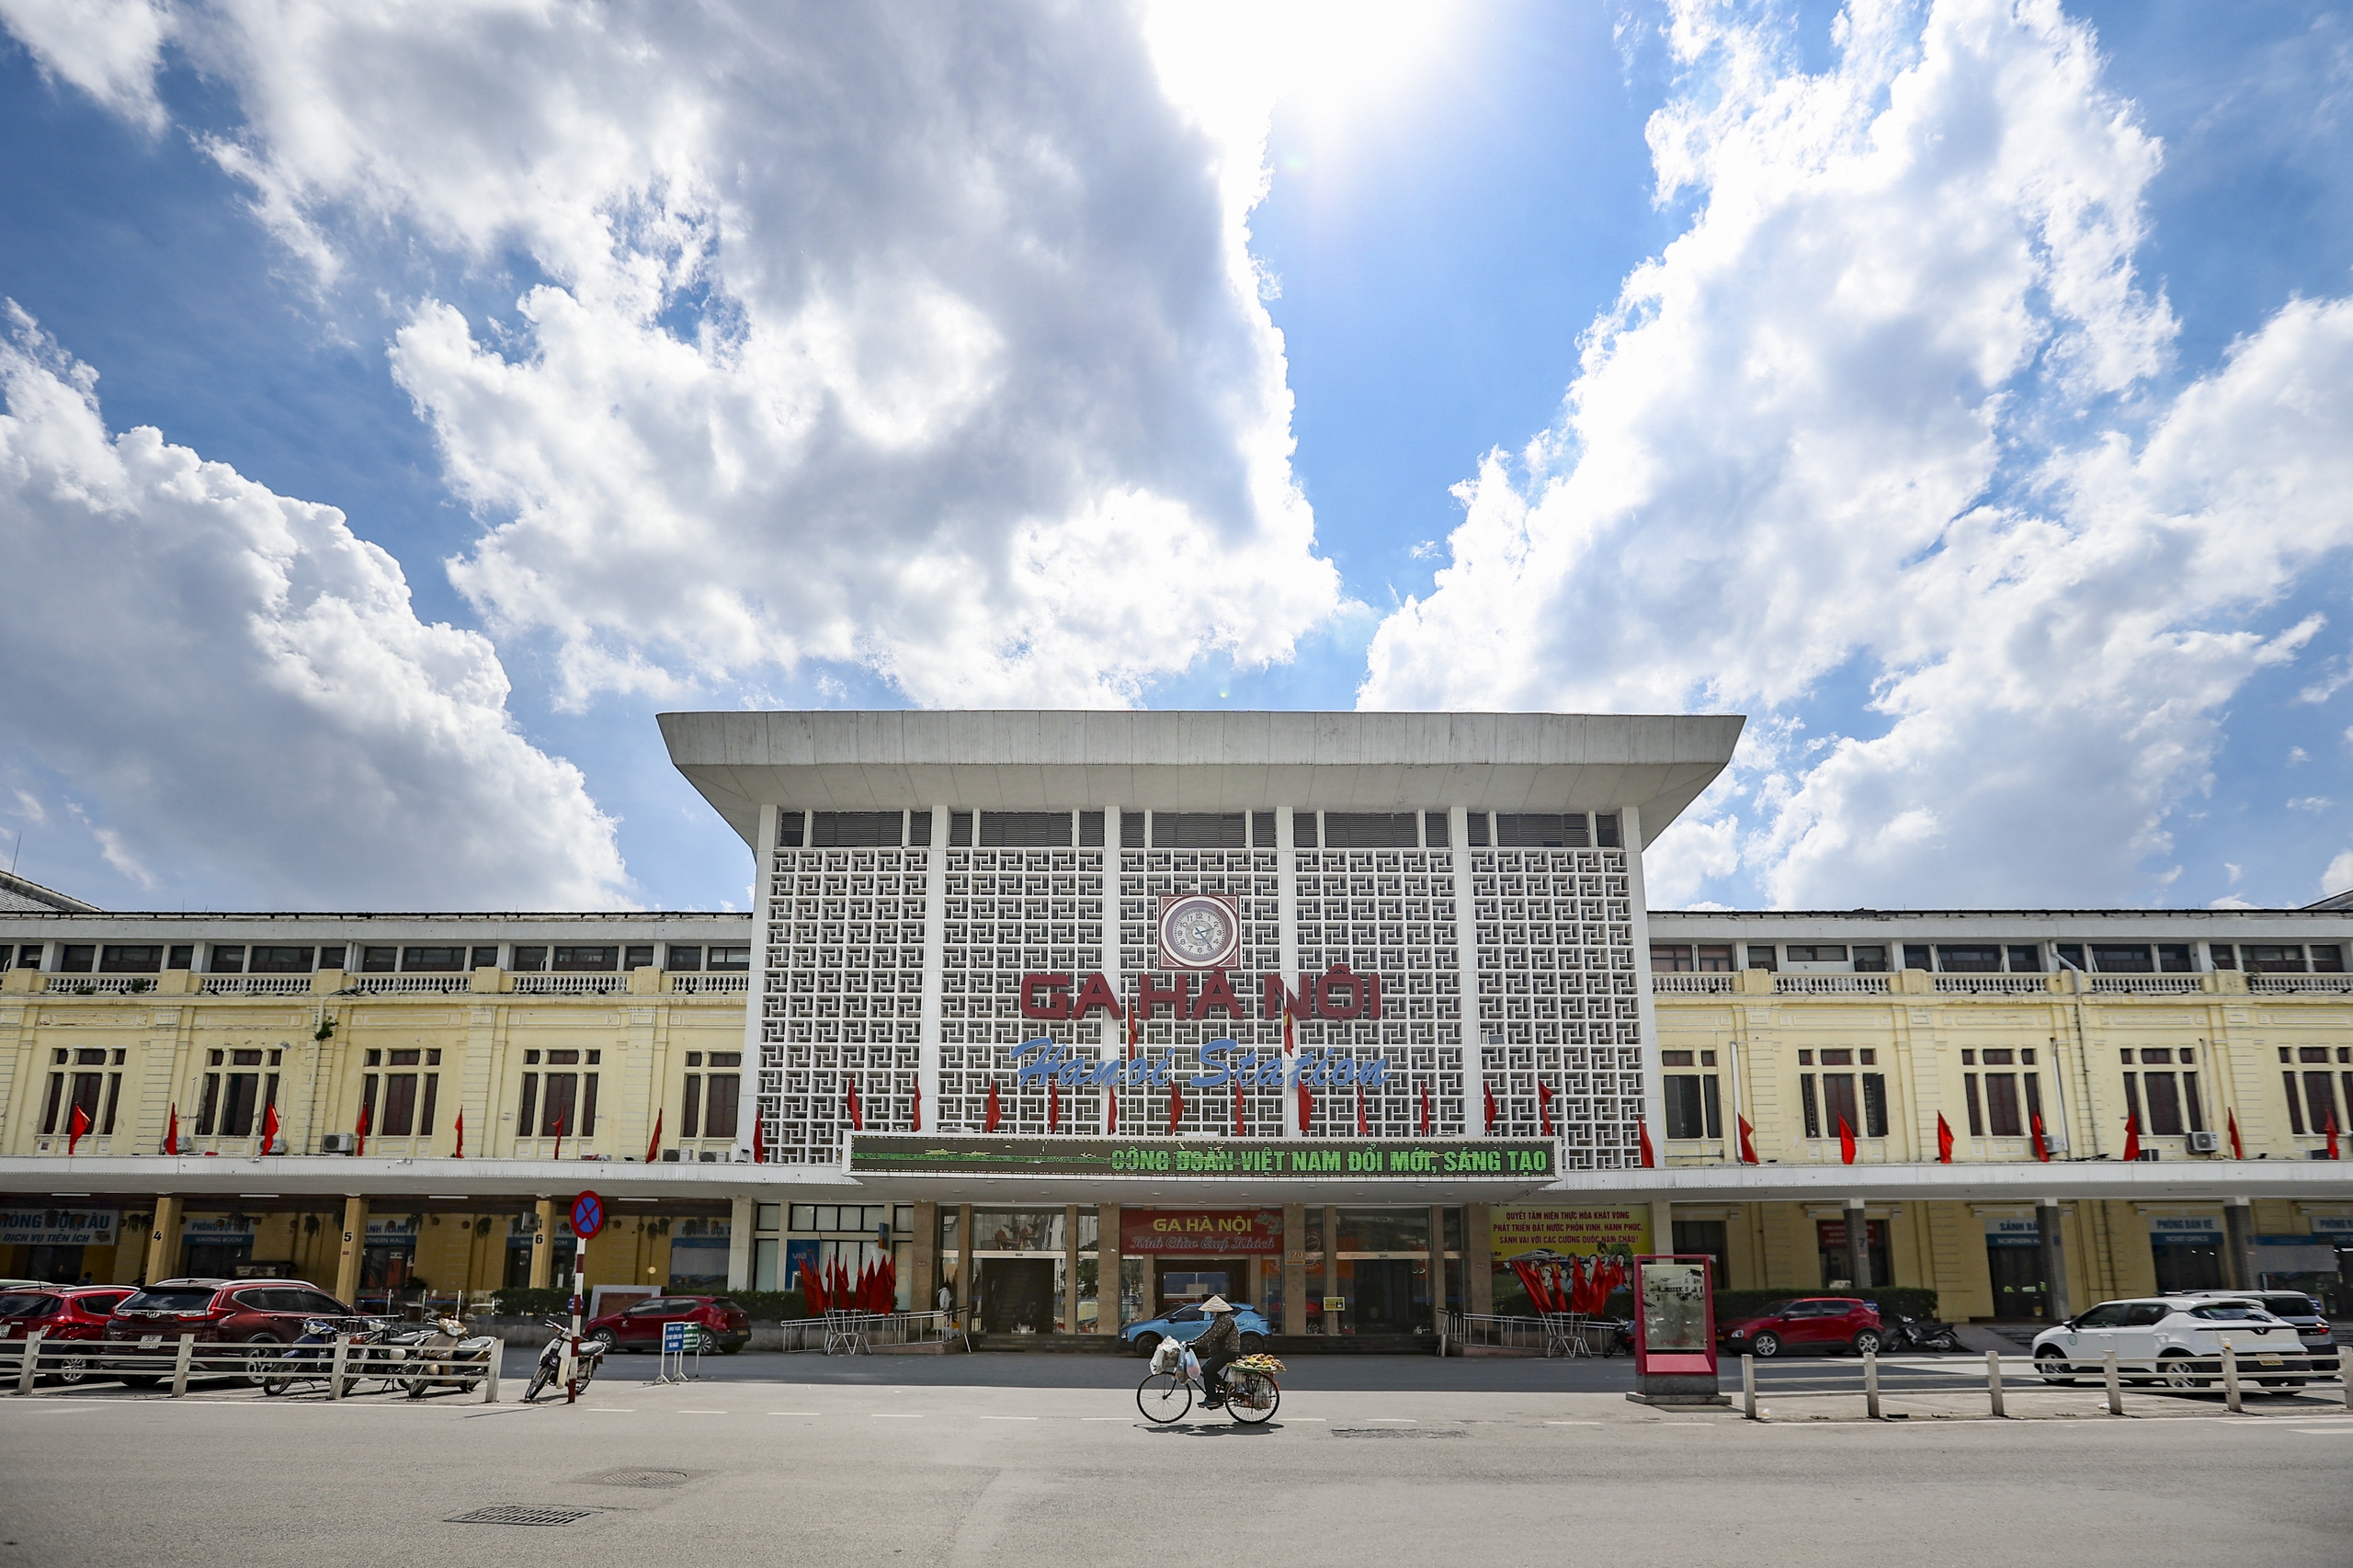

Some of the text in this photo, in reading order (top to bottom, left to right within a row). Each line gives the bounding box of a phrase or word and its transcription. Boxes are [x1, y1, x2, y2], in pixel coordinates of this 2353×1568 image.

[1019, 963, 1381, 1022] GA HÀ NỘI
[1011, 1037, 1392, 1088] Hanoi Station
[1111, 1145, 1169, 1171] CÔNG
[1241, 1146, 1286, 1176] VIỆT
[1291, 1150, 1341, 1171] NAM
[1347, 1142, 1383, 1172] ĐỔI
[1390, 1146, 1438, 1174] MỚI,
[1443, 1146, 1501, 1172] SÁNG
[1507, 1149, 1547, 1176] TẠO
[0, 1211, 42, 1228] ÒNG
[1153, 1215, 1252, 1234] GA HÀ NỘI
[3, 1233, 90, 1244] DỊCH VỤ TIỆN ÍCH
[153, 1231, 162, 1241] 4
[344, 1232, 352, 1242] 5
[535, 1233, 543, 1244] 6
[1518, 1235, 1529, 1244] VAI
[1130, 1236, 1275, 1252] Kính Chào Quý Khách
[1287, 1251, 1303, 1259] 120
